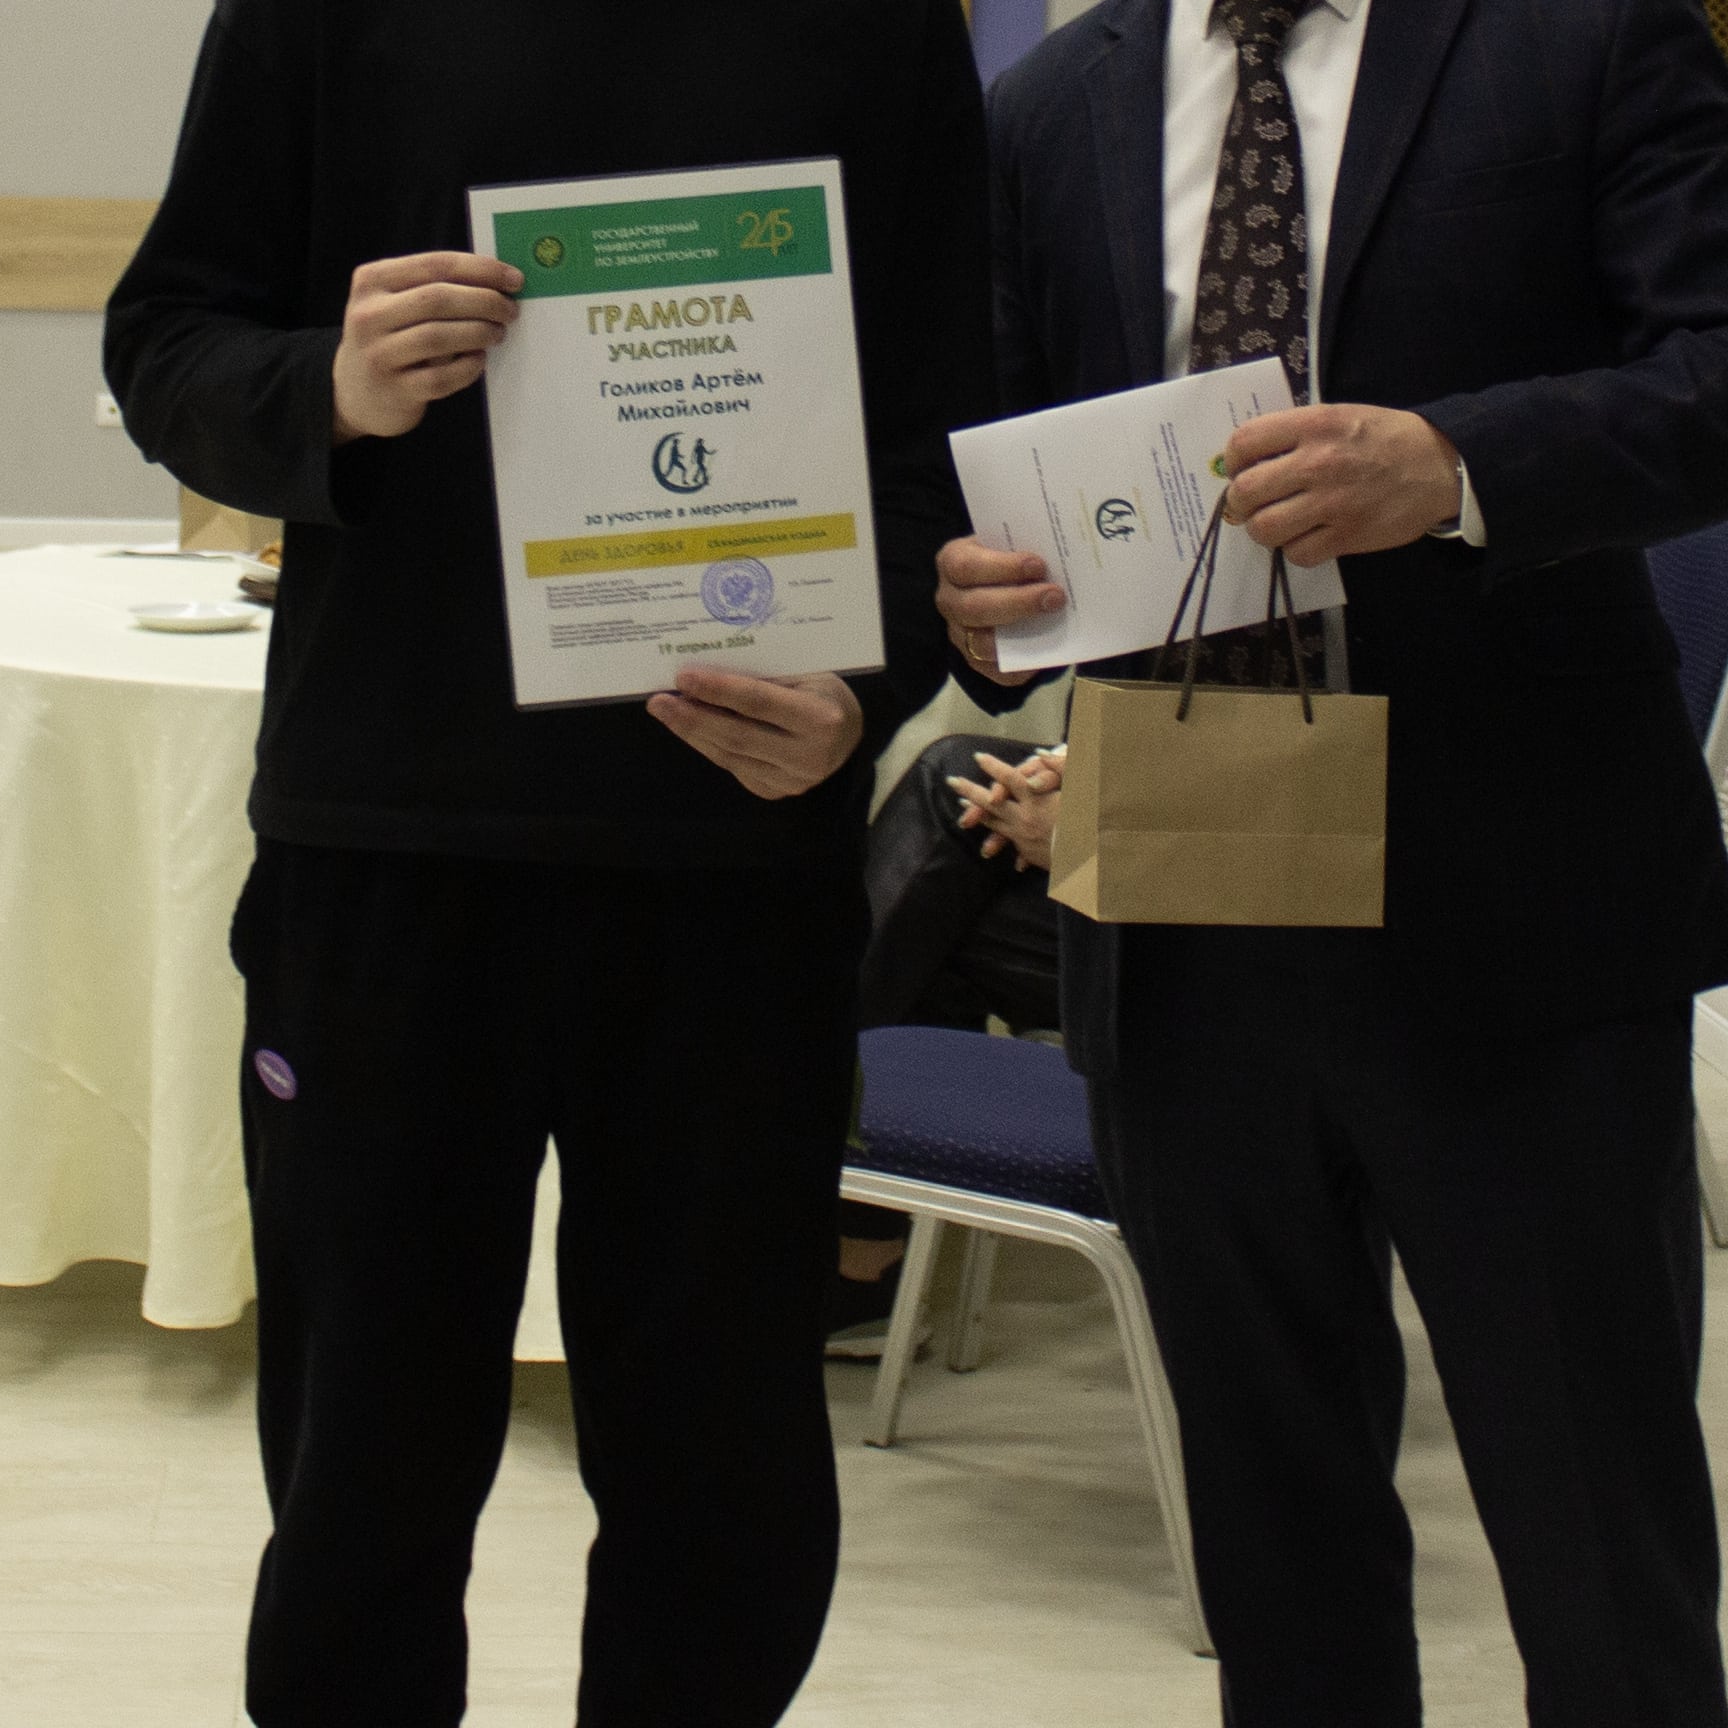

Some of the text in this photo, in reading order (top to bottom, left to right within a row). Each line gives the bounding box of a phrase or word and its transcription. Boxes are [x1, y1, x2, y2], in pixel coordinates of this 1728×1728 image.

[587, 293, 754, 335] ГРАМОТА
[608, 334, 737, 362] УЧАСТНИКА
[599, 368, 765, 398] Голиков Артём
[617, 398, 751, 422] Михайлович
[584, 496, 799, 526] за участие в мероприятии
